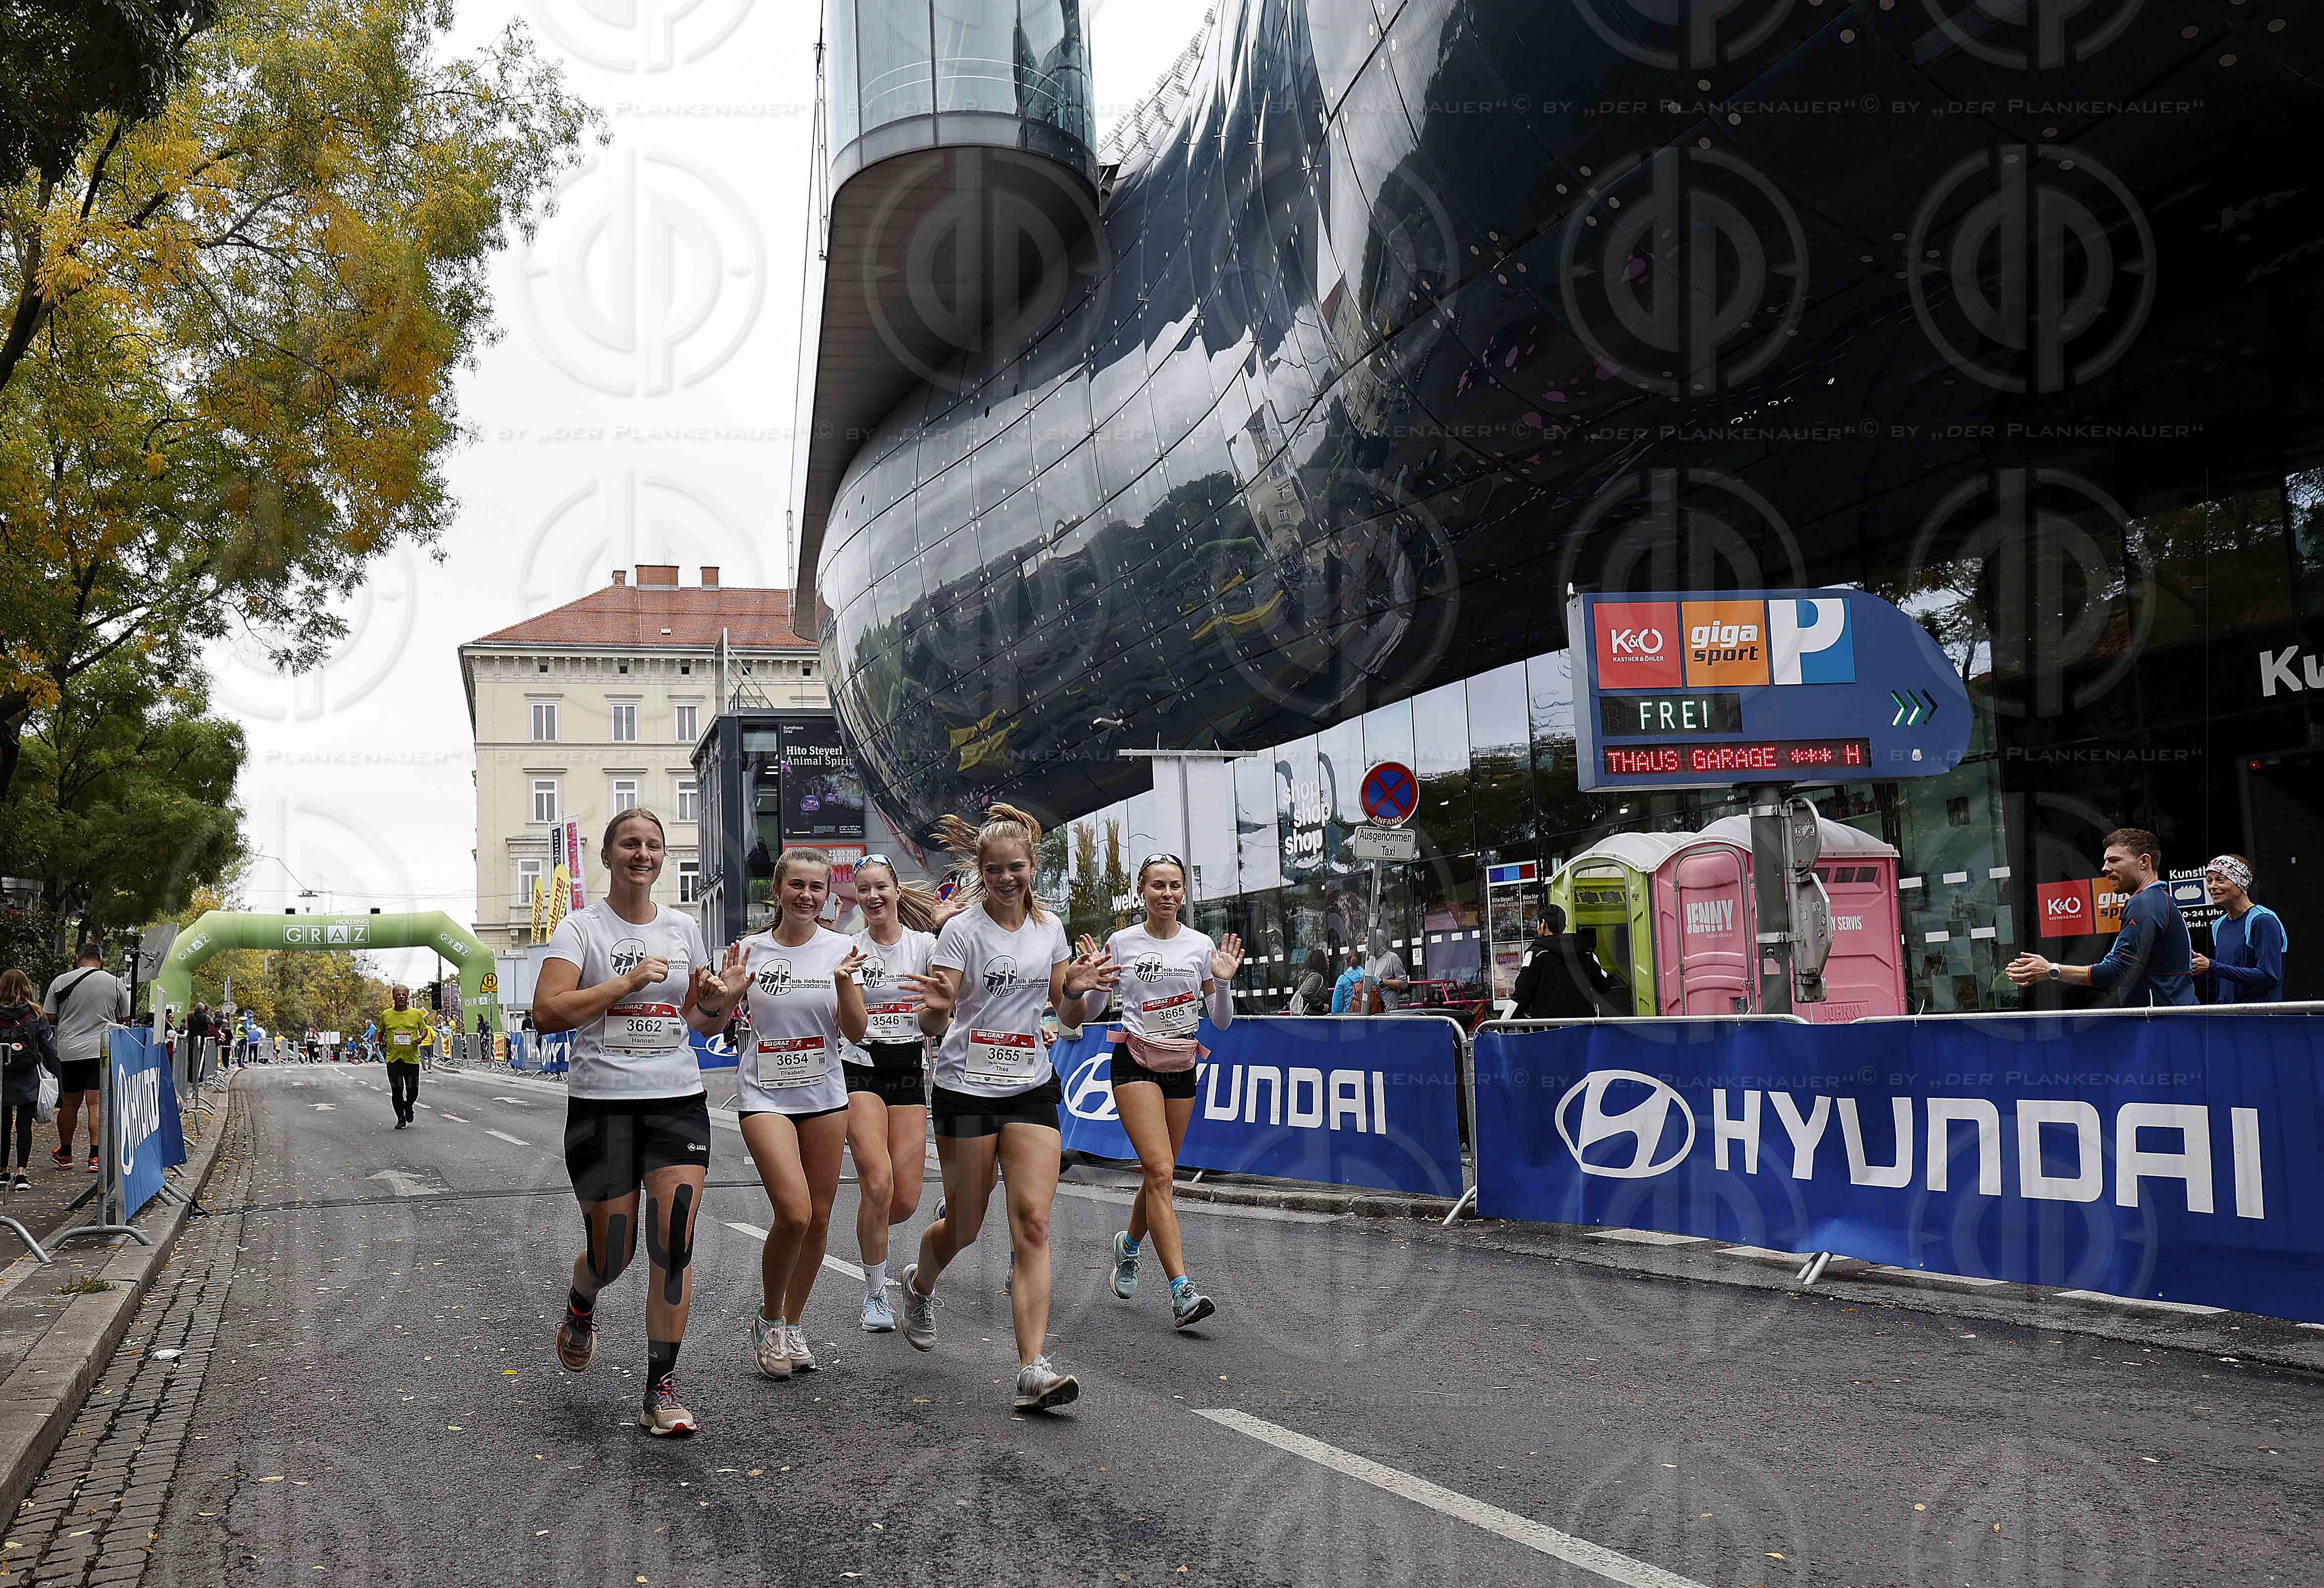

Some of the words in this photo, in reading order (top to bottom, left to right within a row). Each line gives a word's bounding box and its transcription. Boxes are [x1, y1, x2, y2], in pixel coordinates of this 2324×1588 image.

[1690, 620, 1758, 649] giga
[1693, 646, 1759, 666] sport
[1639, 700, 1708, 730] FREI
[786, 745, 807, 755] Hito
[809, 745, 843, 757] Steyerl
[786, 756, 822, 765] Animal
[1606, 749, 1677, 772] THAUS
[1692, 746, 1777, 770] GARAGE
[1284, 778, 1320, 806] shop
[1293, 801, 1331, 828] shop
[1373, 815, 1403, 825] ANFANG
[1285, 828, 1323, 855] shop
[1359, 829, 1412, 843] Ausgenommen
[1382, 845, 1396, 857] Taxi
[1686, 899, 1733, 934] JENNY
[1837, 916, 1862, 931] SERVIS
[285, 925, 369, 944] GRAZ
[178, 933, 211, 961] GRAZ
[439, 931, 473, 958] GRAZ
[872, 1015, 900, 1026] 3546
[1158, 1006, 1185, 1021] 3665
[626, 1019, 662, 1032] 3662
[776, 1052, 809, 1066] 3654
[987, 1047, 1020, 1062] 3655
[1196, 1063, 1386, 1135] UNDAI
[1713, 1088, 2265, 1221] HYUNDAI
